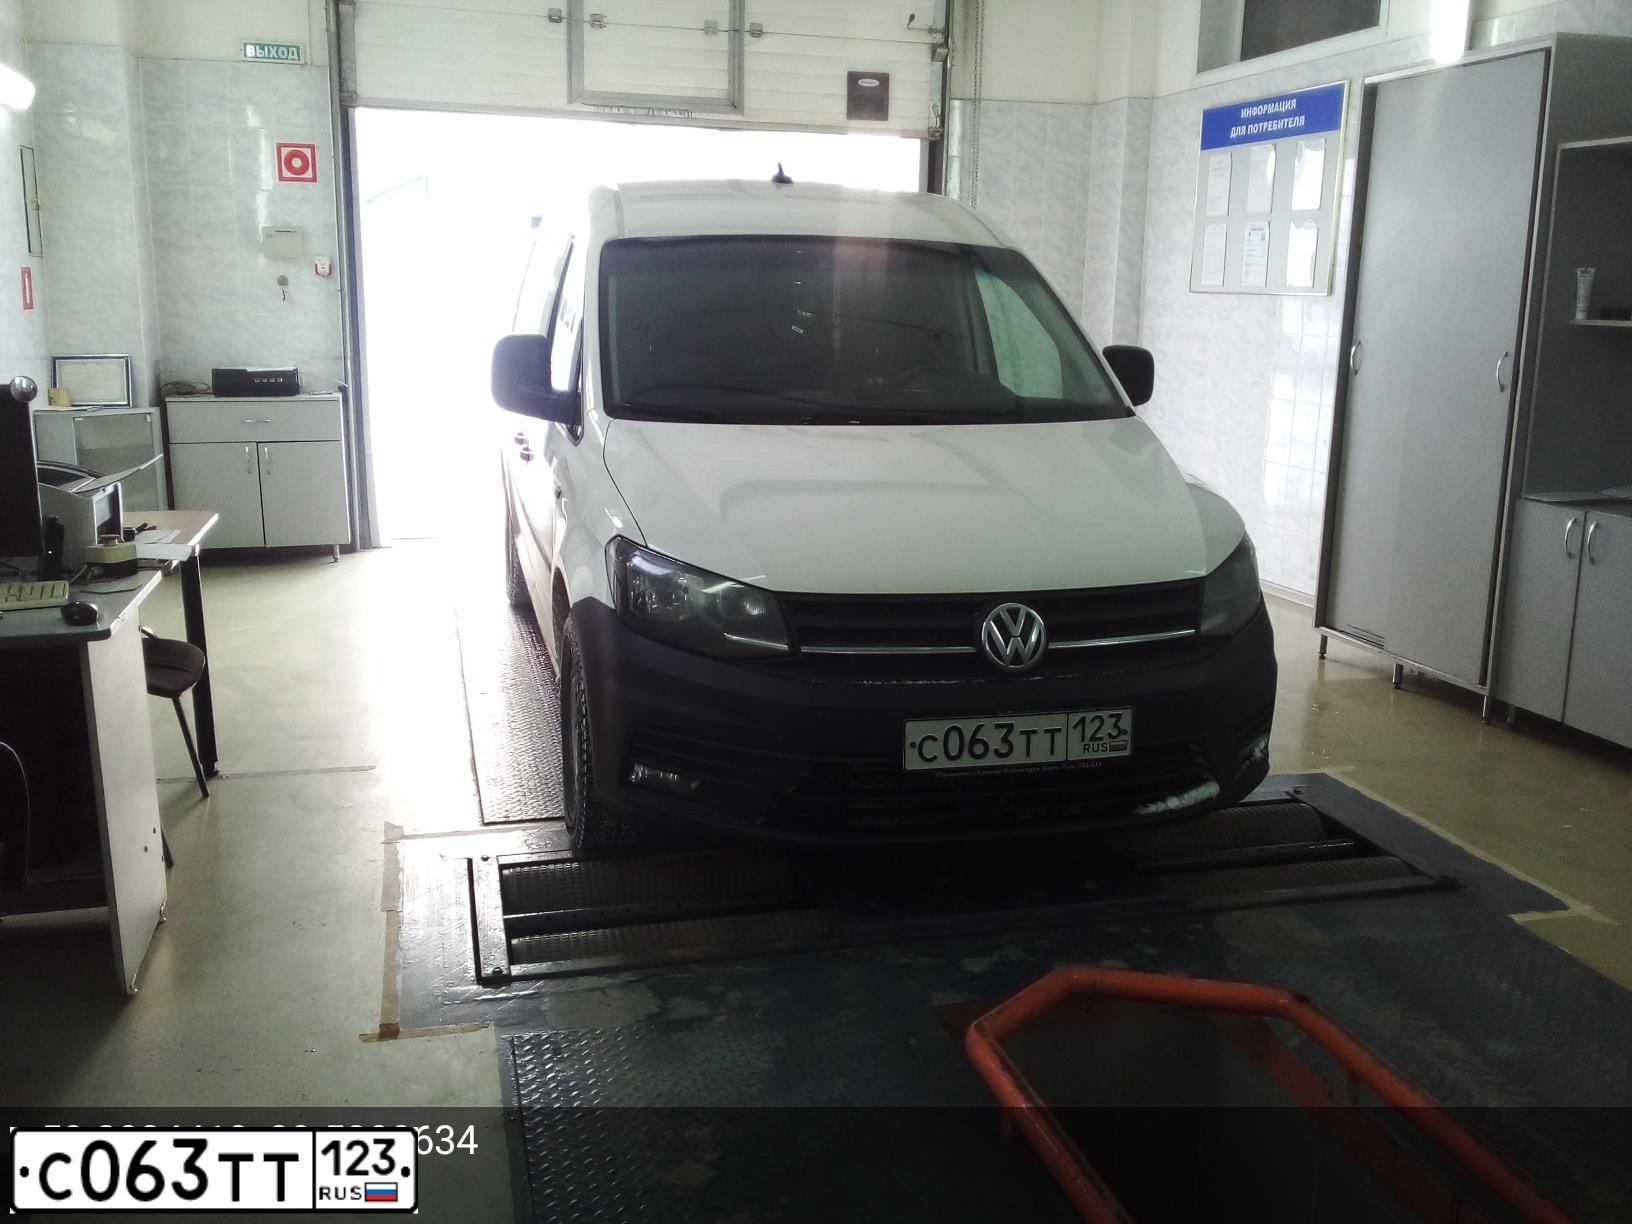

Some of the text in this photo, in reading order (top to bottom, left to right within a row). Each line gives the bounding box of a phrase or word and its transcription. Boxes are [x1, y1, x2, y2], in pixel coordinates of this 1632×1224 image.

[246, 44, 298, 60] ВЫХОД
[1240, 98, 1297, 118] ИНФОРМАЦИЯ
[1230, 115, 1305, 139] ДЛЯ ПОТРЕБИТЕЛЯ
[1072, 713, 1123, 743] 123
[1083, 742, 1108, 754] RUS
